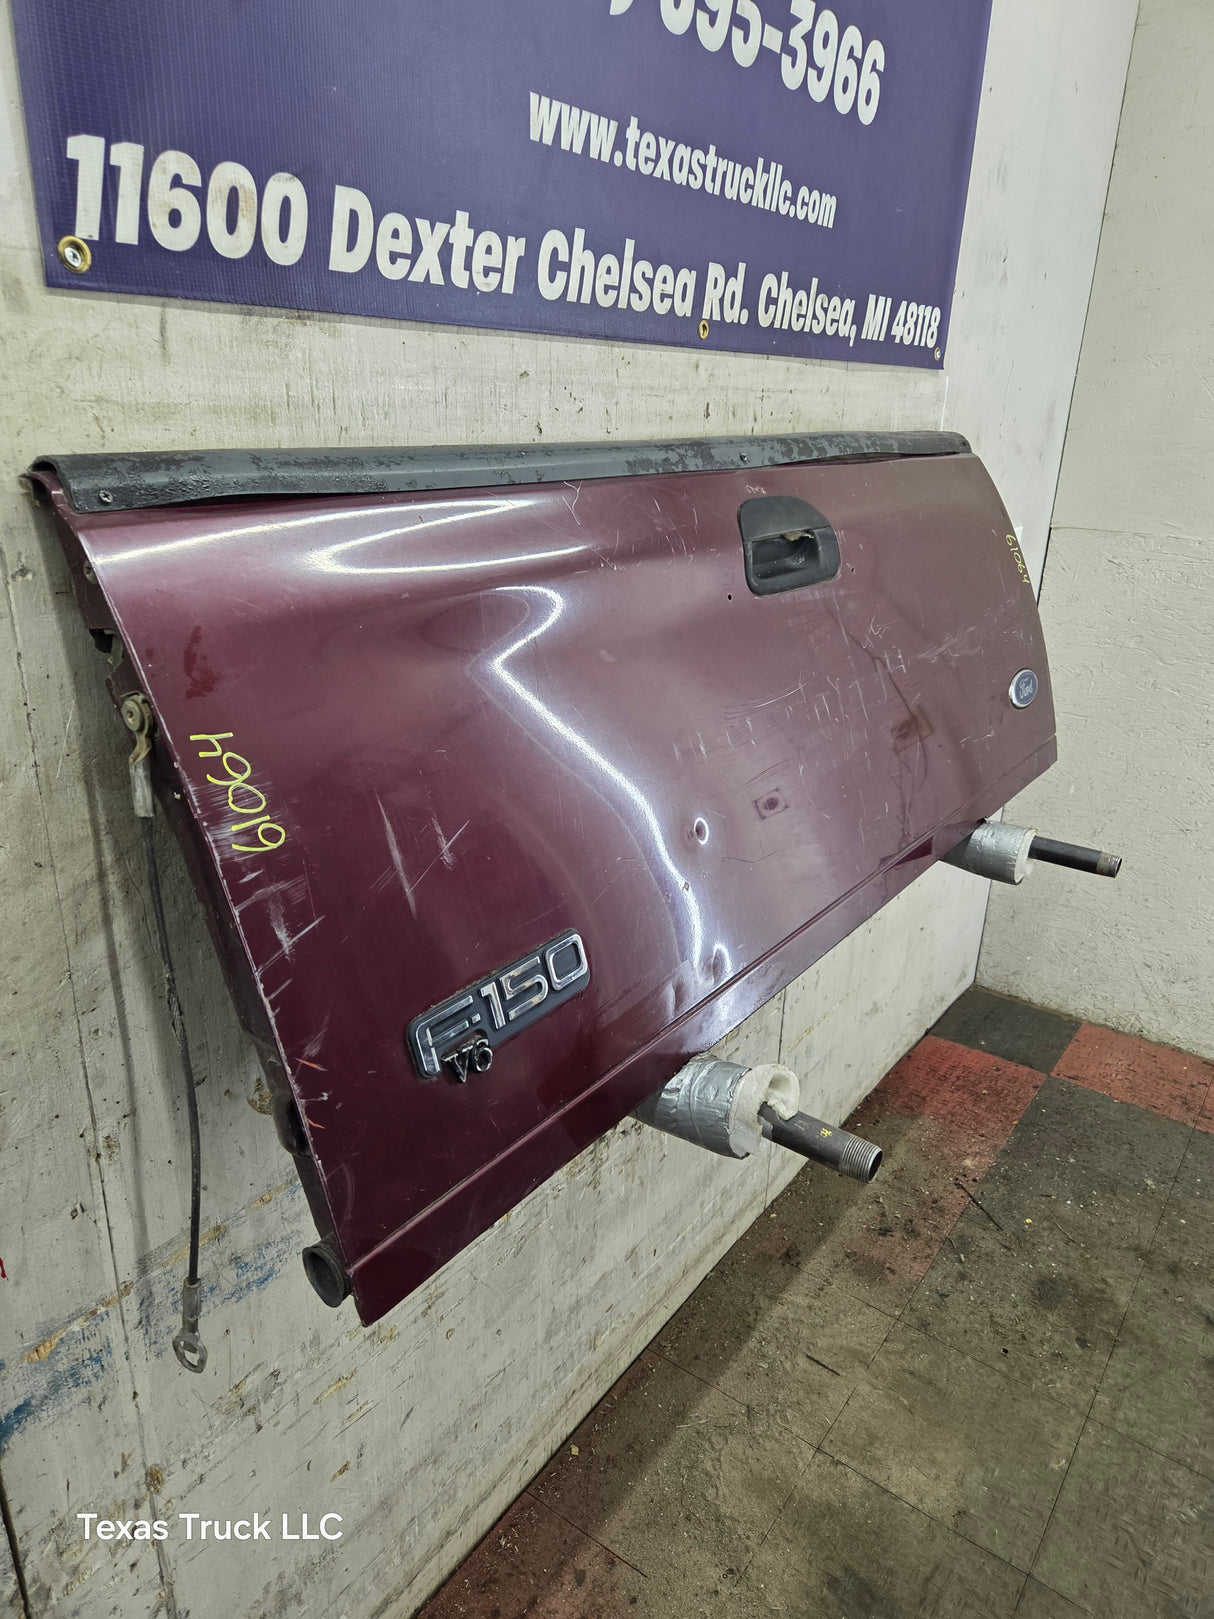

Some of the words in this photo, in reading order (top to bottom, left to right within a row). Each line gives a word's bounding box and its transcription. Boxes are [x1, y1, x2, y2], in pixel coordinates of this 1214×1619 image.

[529, 91, 838, 229] www.texastruckllc.com
[66, 133, 309, 266] 11600
[328, 184, 526, 296] Dexter
[537, 227, 697, 318] Chelsea
[701, 261, 749, 326] Rd.
[757, 272, 857, 348] Chelsea,
[860, 293, 893, 342] MI
[890, 299, 941, 349] 48118
[1005, 533, 1031, 585] 61064
[1019, 677, 1034, 700] Ford
[189, 731, 286, 852] 61064
[440, 1037, 494, 1084] V6
